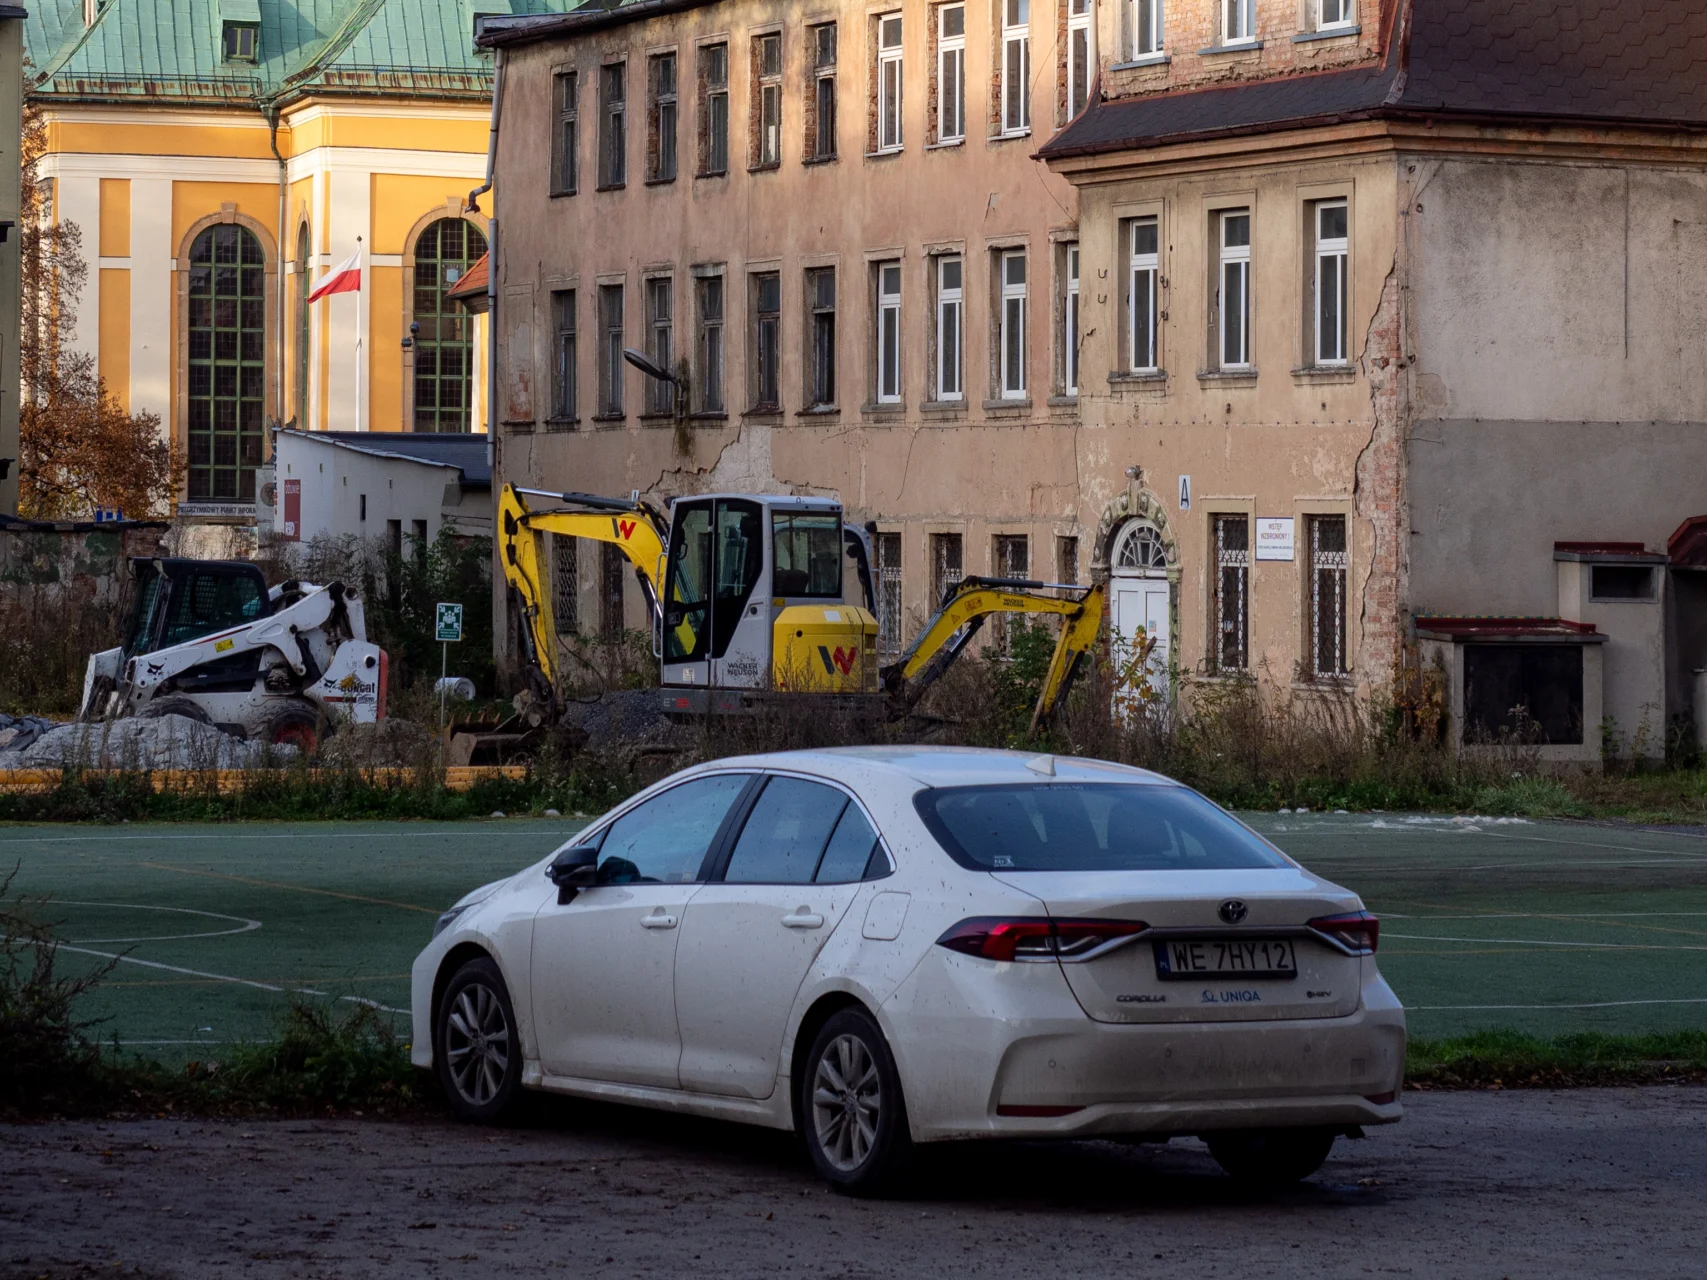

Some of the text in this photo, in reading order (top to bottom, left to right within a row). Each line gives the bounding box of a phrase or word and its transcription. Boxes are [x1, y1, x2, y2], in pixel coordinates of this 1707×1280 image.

[1181, 478, 1189, 506] A
[1172, 942, 1290, 971] WE 7HY12
[1116, 994, 1166, 1003] COROLLA
[1220, 990, 1261, 1003] UNIQA
